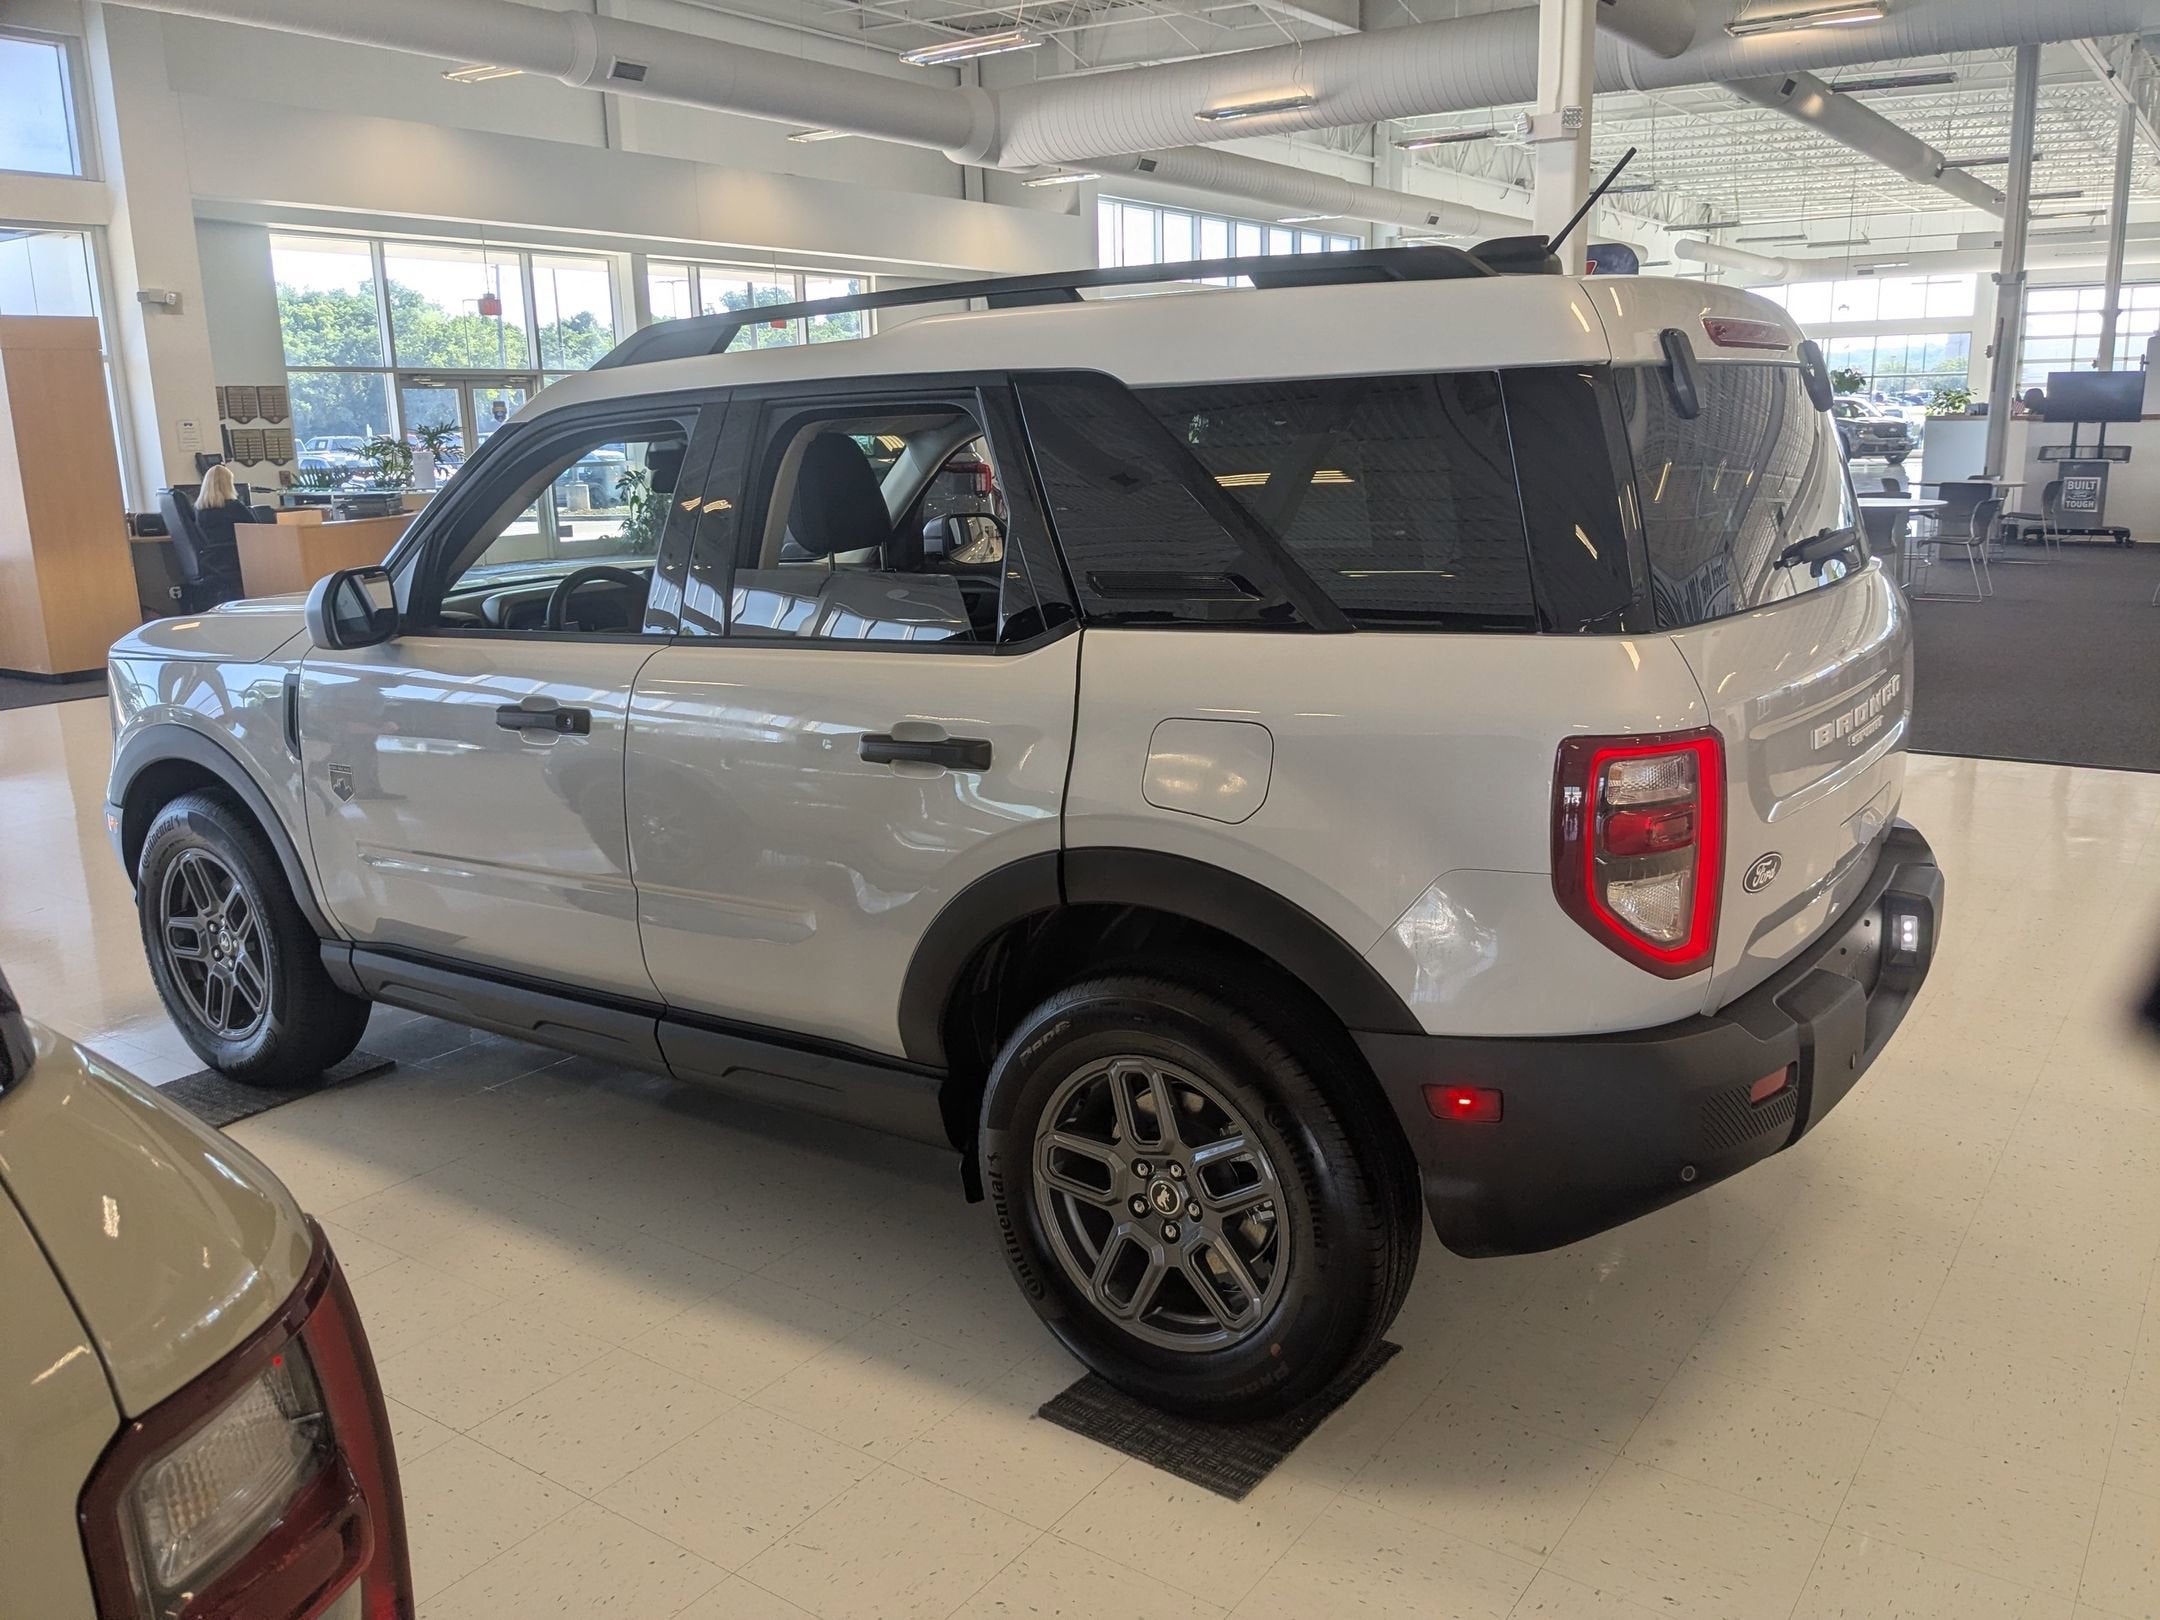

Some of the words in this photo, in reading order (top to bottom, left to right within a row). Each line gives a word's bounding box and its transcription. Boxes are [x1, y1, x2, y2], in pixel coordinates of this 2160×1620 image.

[2067, 480, 2097, 490] BUILT
[2065, 500, 2095, 508] TOUGH
[988, 1169, 1045, 1301] Continental
